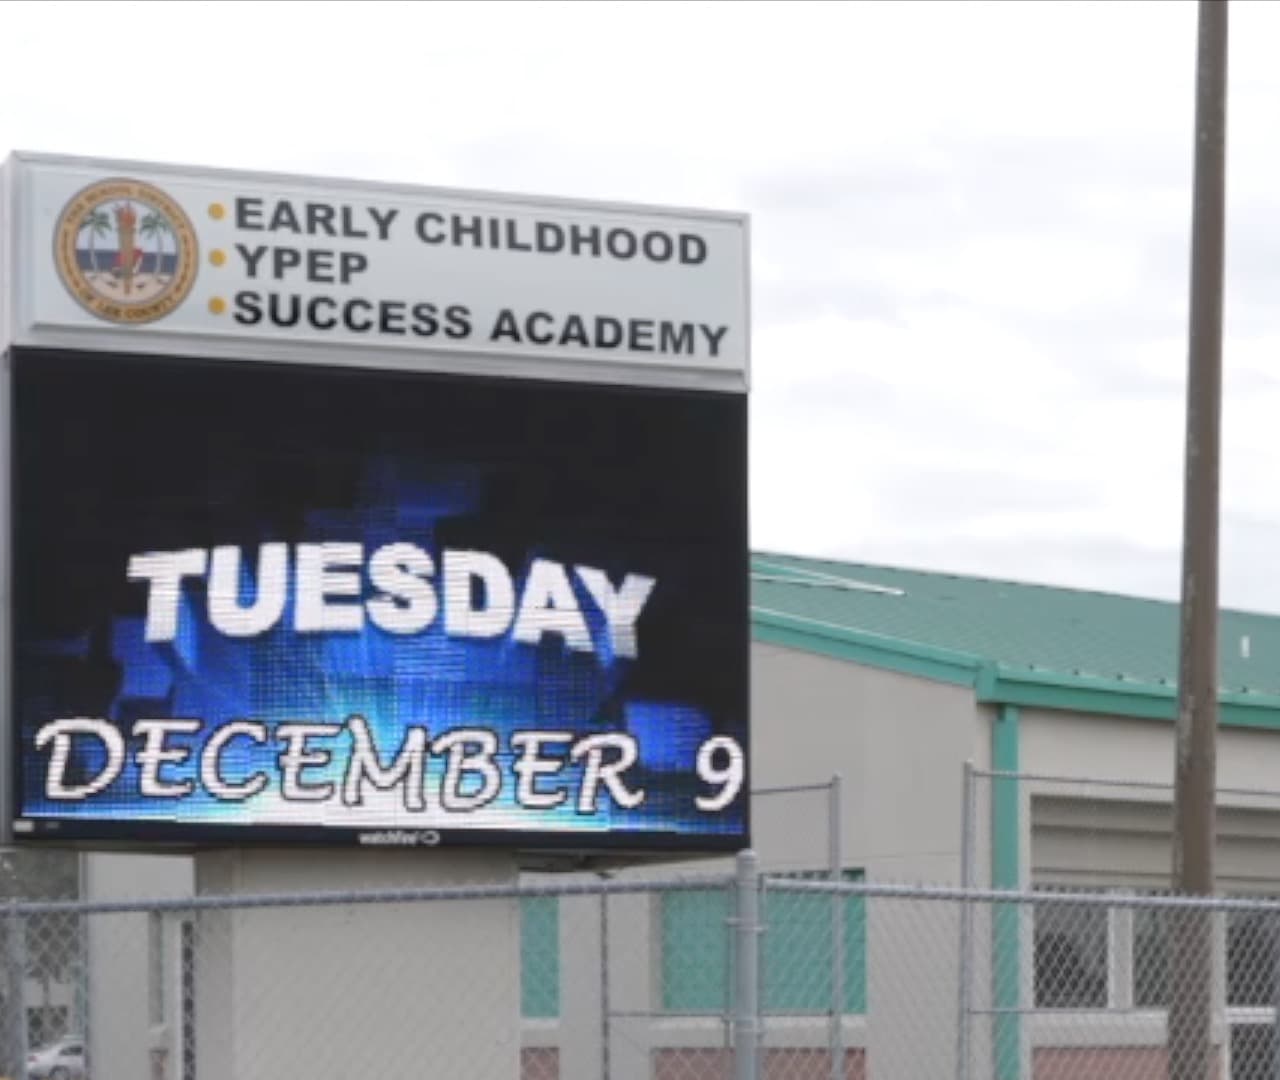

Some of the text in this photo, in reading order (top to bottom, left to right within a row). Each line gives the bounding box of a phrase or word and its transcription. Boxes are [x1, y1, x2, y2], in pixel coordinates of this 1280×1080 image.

[234, 197, 708, 265] EARLY CHILDHOOD
[235, 244, 368, 284] YPEP
[233, 291, 729, 356] SUCCESS ACADEMY
[127, 543, 656, 659] TUESDAY
[34, 717, 745, 814] DECEMBER 9
